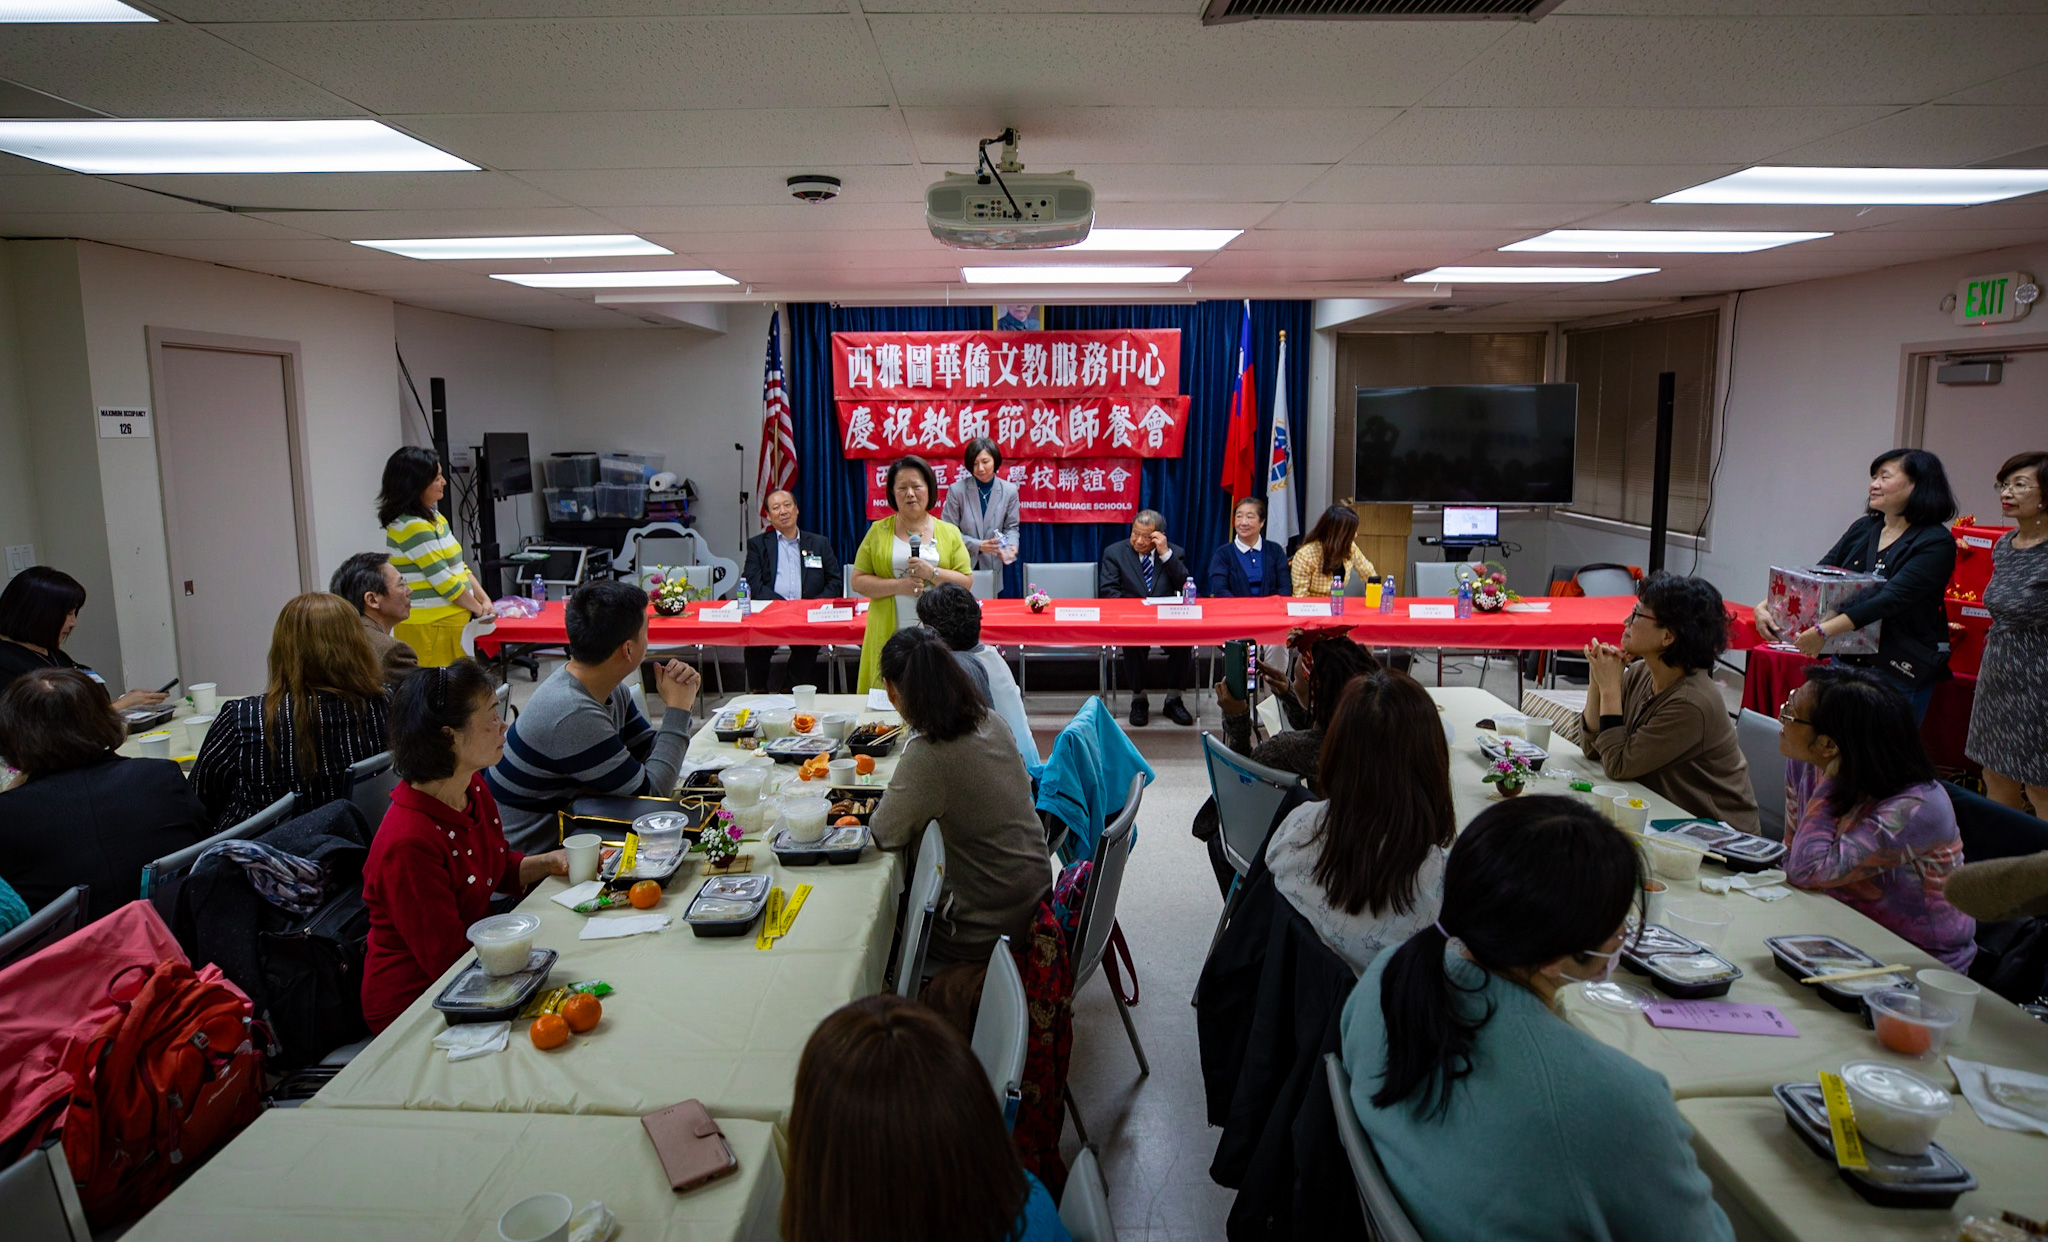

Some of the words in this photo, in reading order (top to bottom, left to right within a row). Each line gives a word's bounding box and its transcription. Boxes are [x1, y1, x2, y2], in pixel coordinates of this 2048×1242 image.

[1965, 278, 2009, 318] EXIT
[846, 340, 1166, 389] 西雅圖華僑文教服務中心
[119, 423, 132, 434] 126
[844, 403, 1175, 451] 慶祝教師節敬師餐會
[1019, 500, 1048, 509] HINESE
[1048, 501, 1092, 511] LANGUAGE
[1093, 502, 1133, 511] SCHOOLS
